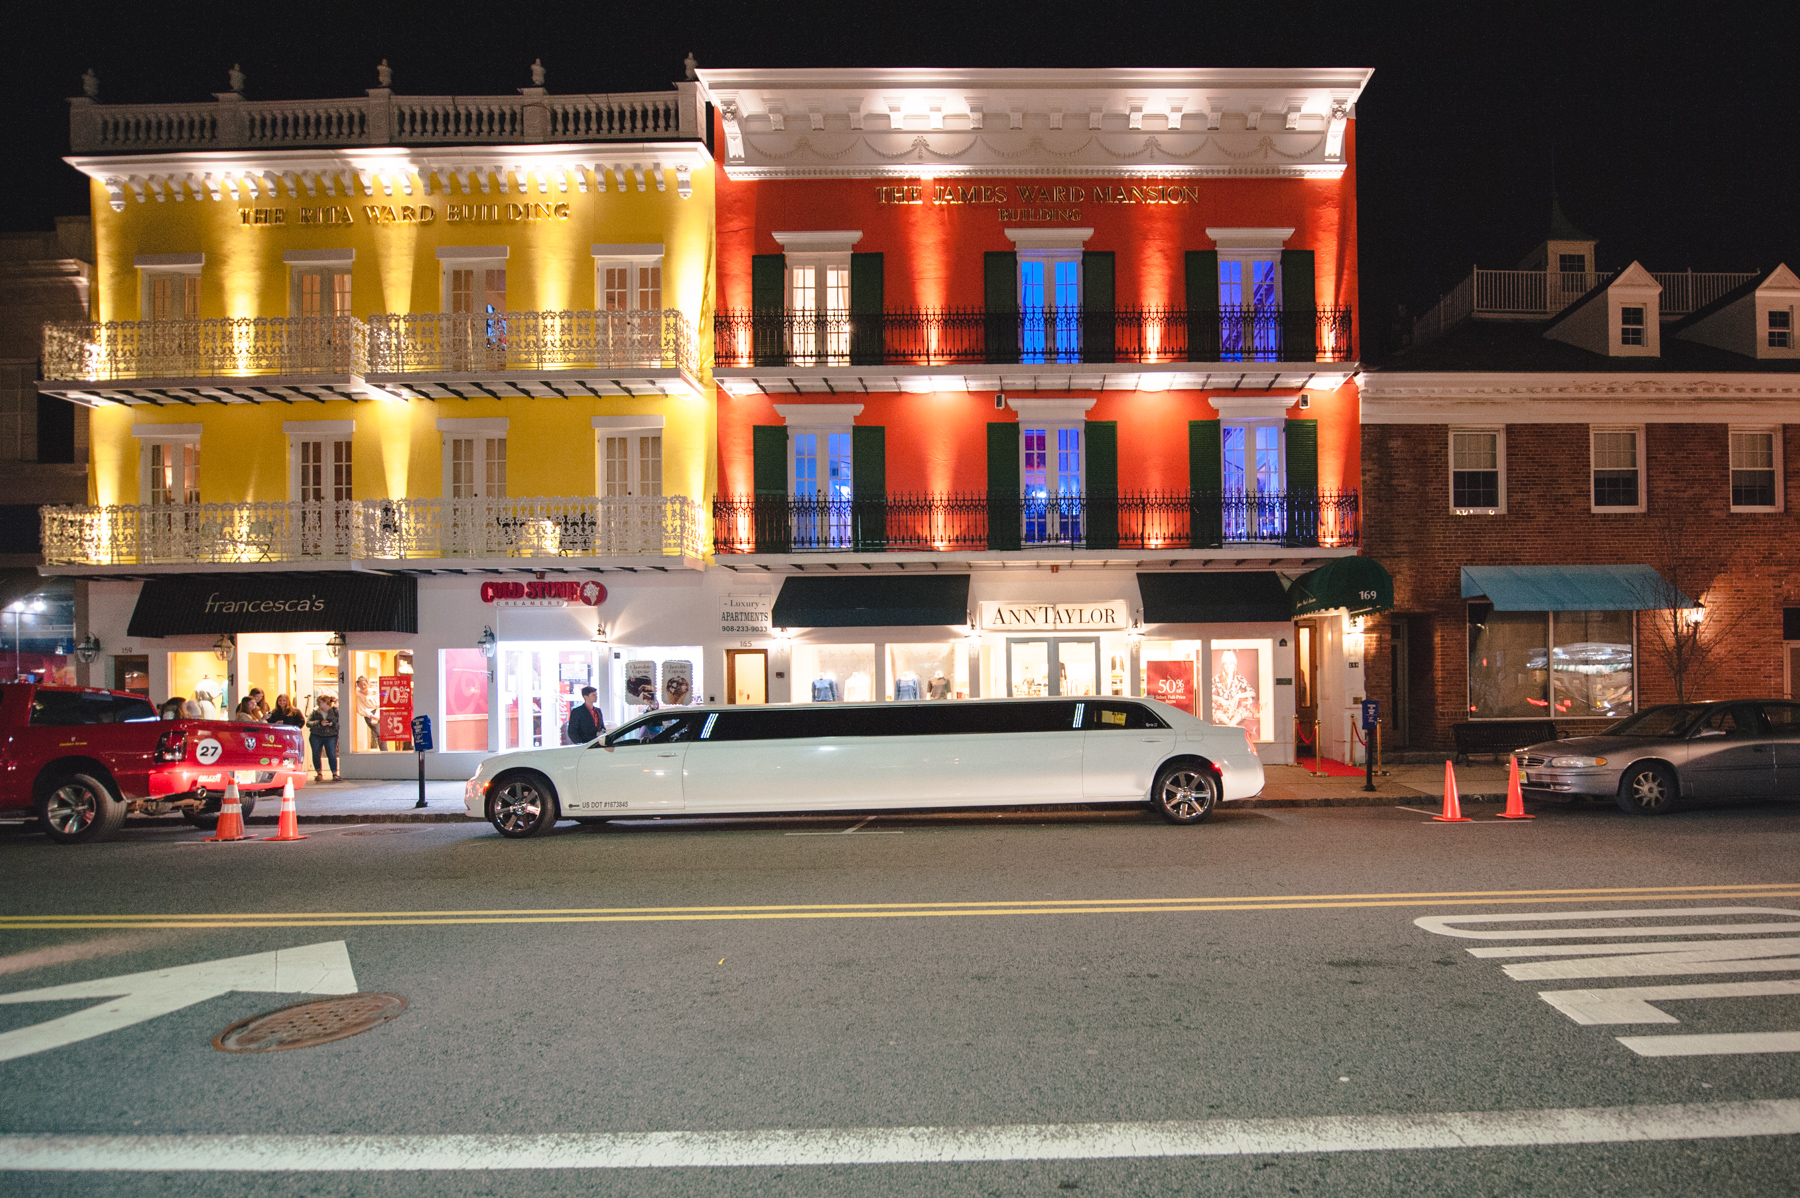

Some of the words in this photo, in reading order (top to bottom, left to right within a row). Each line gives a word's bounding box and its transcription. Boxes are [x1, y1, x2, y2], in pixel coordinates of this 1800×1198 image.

[876, 185, 924, 205] THE
[932, 185, 1008, 206] JAMES
[1016, 185, 1085, 205] WARD
[1093, 185, 1200, 205] MANSION
[237, 206, 286, 226] THE
[300, 204, 354, 225] RITA
[363, 203, 435, 224] WARD
[997, 208, 1082, 222] BUILDING
[480, 581, 525, 603] COLD
[525, 581, 581, 602] STONE
[1358, 590, 1378, 600] 169
[204, 592, 325, 613] francesca's
[730, 599, 760, 610] Luxury
[720, 611, 769, 622] APARTMENTS
[992, 606, 1117, 625] ANNTAYLOR
[121, 646, 133, 654] 159
[740, 640, 753, 648] 165
[1157, 679, 1185, 694] 50%
[387, 716, 404, 734] $5
[200, 746, 219, 757] 27
